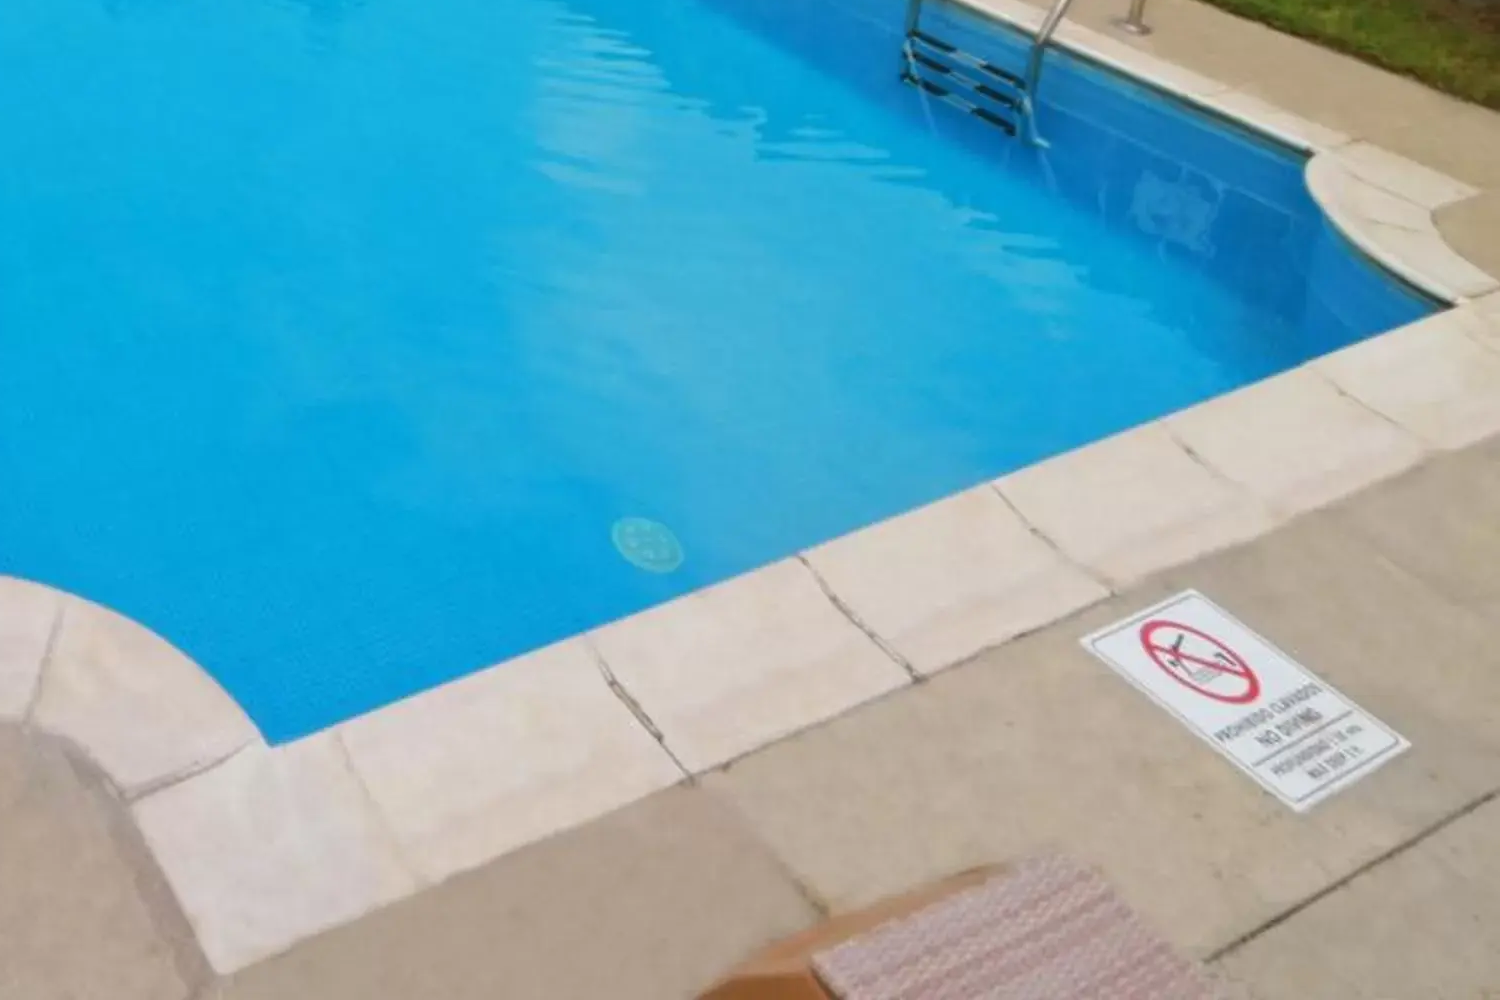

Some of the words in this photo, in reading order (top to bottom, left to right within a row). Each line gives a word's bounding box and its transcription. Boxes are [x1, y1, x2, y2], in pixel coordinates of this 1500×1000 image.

[1213, 707, 1275, 742] PROHIBIDO
[1269, 682, 1324, 714] CLAVADOS
[1254, 729, 1283, 746] NO
[1275, 706, 1323, 737] DIVING
